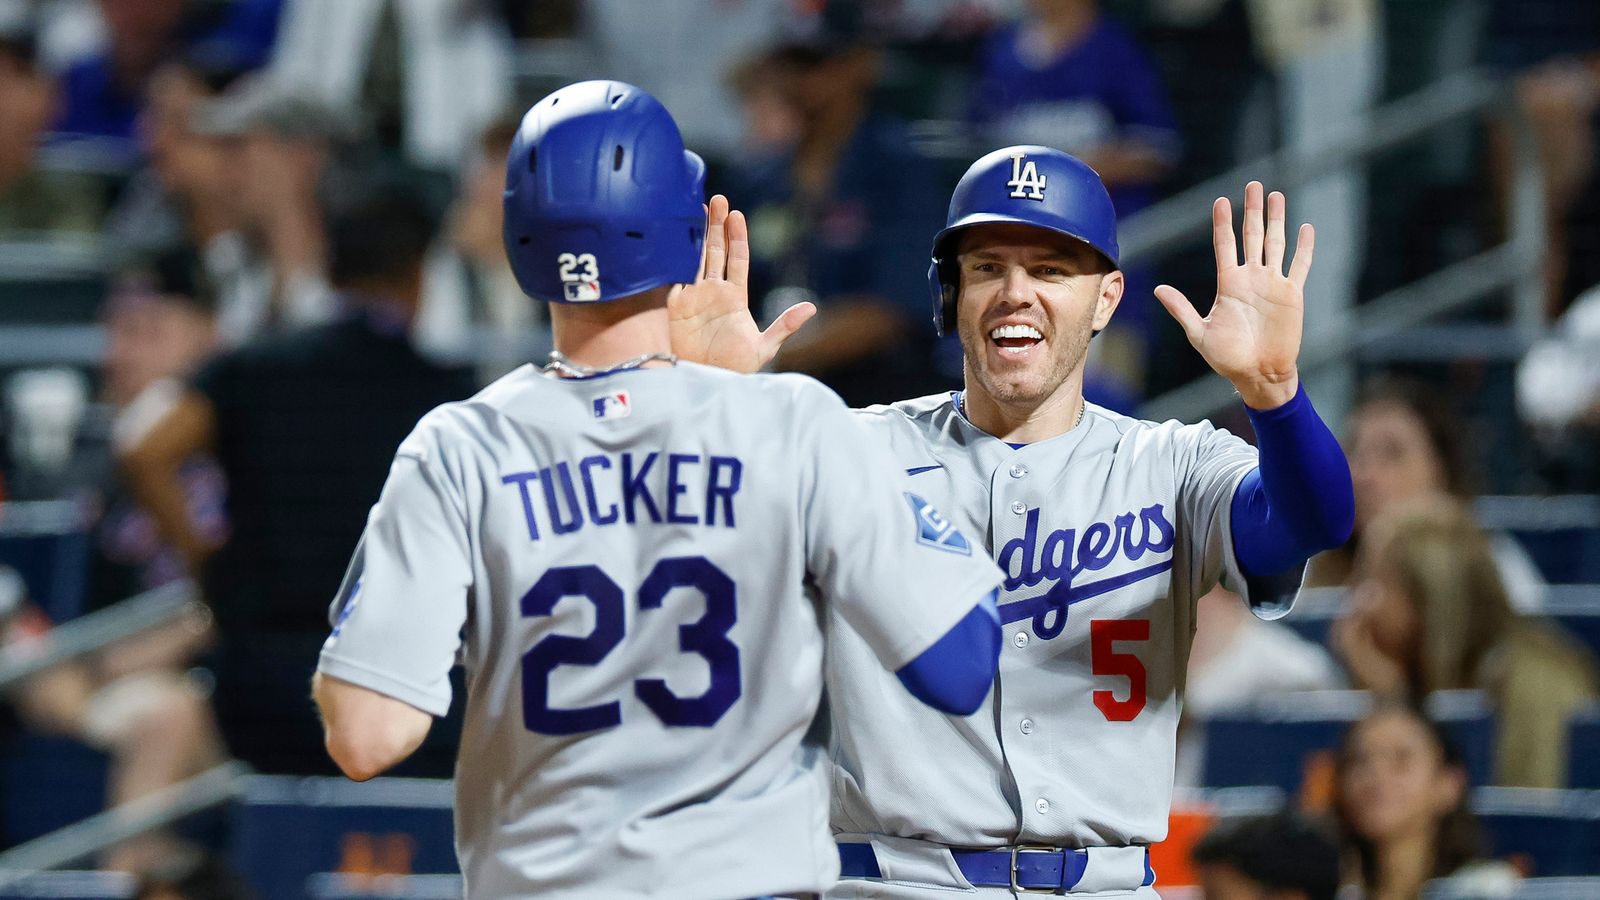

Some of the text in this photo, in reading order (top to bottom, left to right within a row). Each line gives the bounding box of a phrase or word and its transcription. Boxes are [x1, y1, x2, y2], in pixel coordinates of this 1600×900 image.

[1007, 153, 1047, 201] LA
[557, 252, 599, 282] 23
[501, 451, 743, 541] TUCKER
[997, 503, 1176, 641] dgers
[519, 555, 743, 736] 23
[1090, 619, 1150, 722] 5
